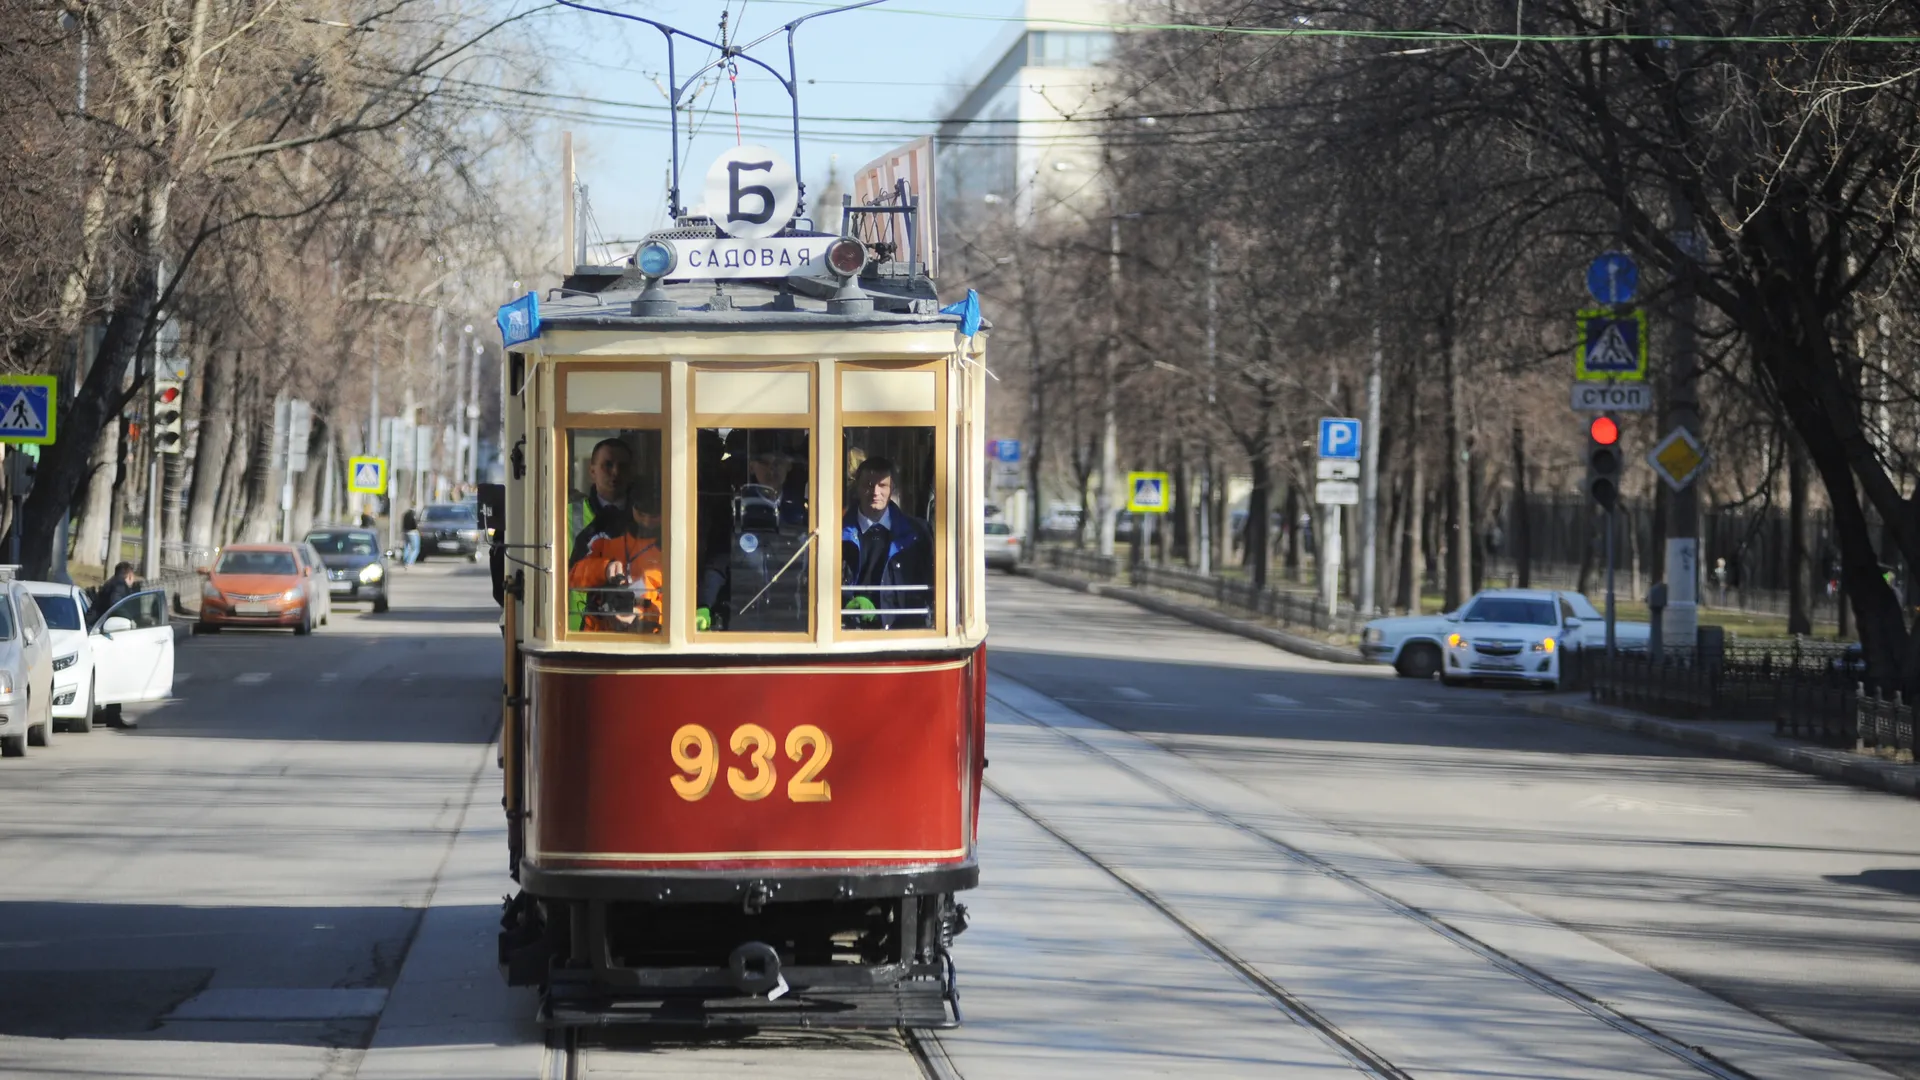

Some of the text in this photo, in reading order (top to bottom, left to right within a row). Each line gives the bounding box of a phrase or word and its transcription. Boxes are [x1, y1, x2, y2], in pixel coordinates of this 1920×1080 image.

[727, 160, 776, 224] Б
[689, 248, 810, 268] САДОВАЯ
[1582, 389, 1640, 404] СТОП
[1328, 423, 1352, 454] P
[670, 723, 833, 802] 932
